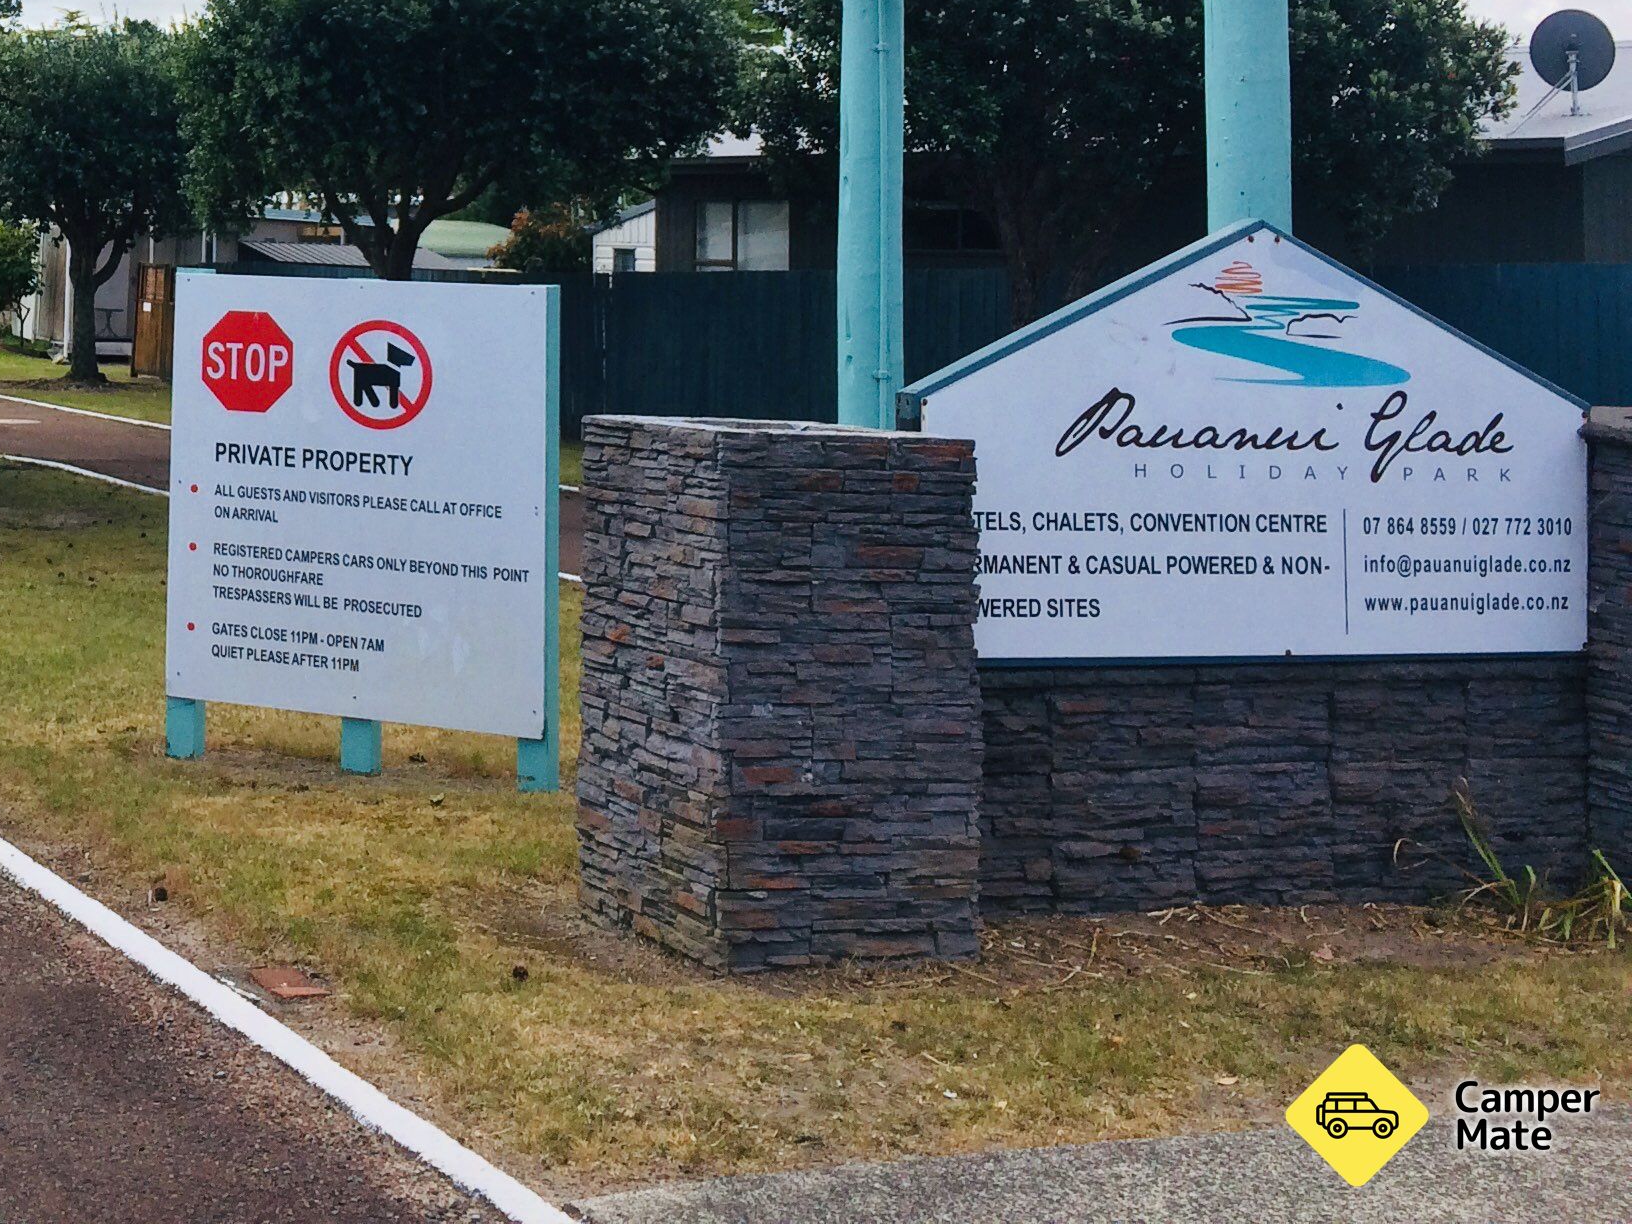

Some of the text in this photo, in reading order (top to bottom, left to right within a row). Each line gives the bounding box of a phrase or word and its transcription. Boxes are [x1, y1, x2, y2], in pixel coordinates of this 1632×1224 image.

[206, 341, 289, 383] STOP
[1364, 390, 1514, 484] Glade
[215, 442, 414, 477] PRIVATE PROPERTY
[1134, 463, 1511, 482] HOLIDAY PARK
[214, 483, 502, 519] ALL GUESTS AND VISITORS PLEASE CALL AT OFFICE
[214, 505, 279, 524] ON ARRIVAL
[973, 511, 1328, 536] TELS, CHALETS, CONVENTION CENTRE
[1363, 516, 1572, 536] 07 864 8559 / 027 772 3010
[212, 563, 324, 587] NO THOROUGHFARE
[213, 542, 530, 583] REGISTERED CAMPERS CARS ONLY BEYOND THIS POINT
[1067, 554, 1081, 575] &
[1085, 554, 1162, 575] CASUAL
[1166, 555, 1258, 575] POWERED
[1262, 555, 1275, 575] &
[1281, 555, 1330, 575] NON-
[1364, 554, 1571, 578] info@pauanuiglade.co.nz
[212, 584, 423, 619] TRESPASSERS WILL BE PROSECUTED
[1046, 598, 1101, 618] SITES
[1364, 592, 1569, 616] www.pauanuiglade.co.nz
[211, 621, 248, 638] GATES
[250, 625, 288, 643] CLOSE
[290, 630, 318, 646] 11PM
[326, 633, 359, 650] OPEN
[360, 637, 385, 653] 7AM
[211, 643, 360, 672] QUIET PLEASE AFTER 11PM
